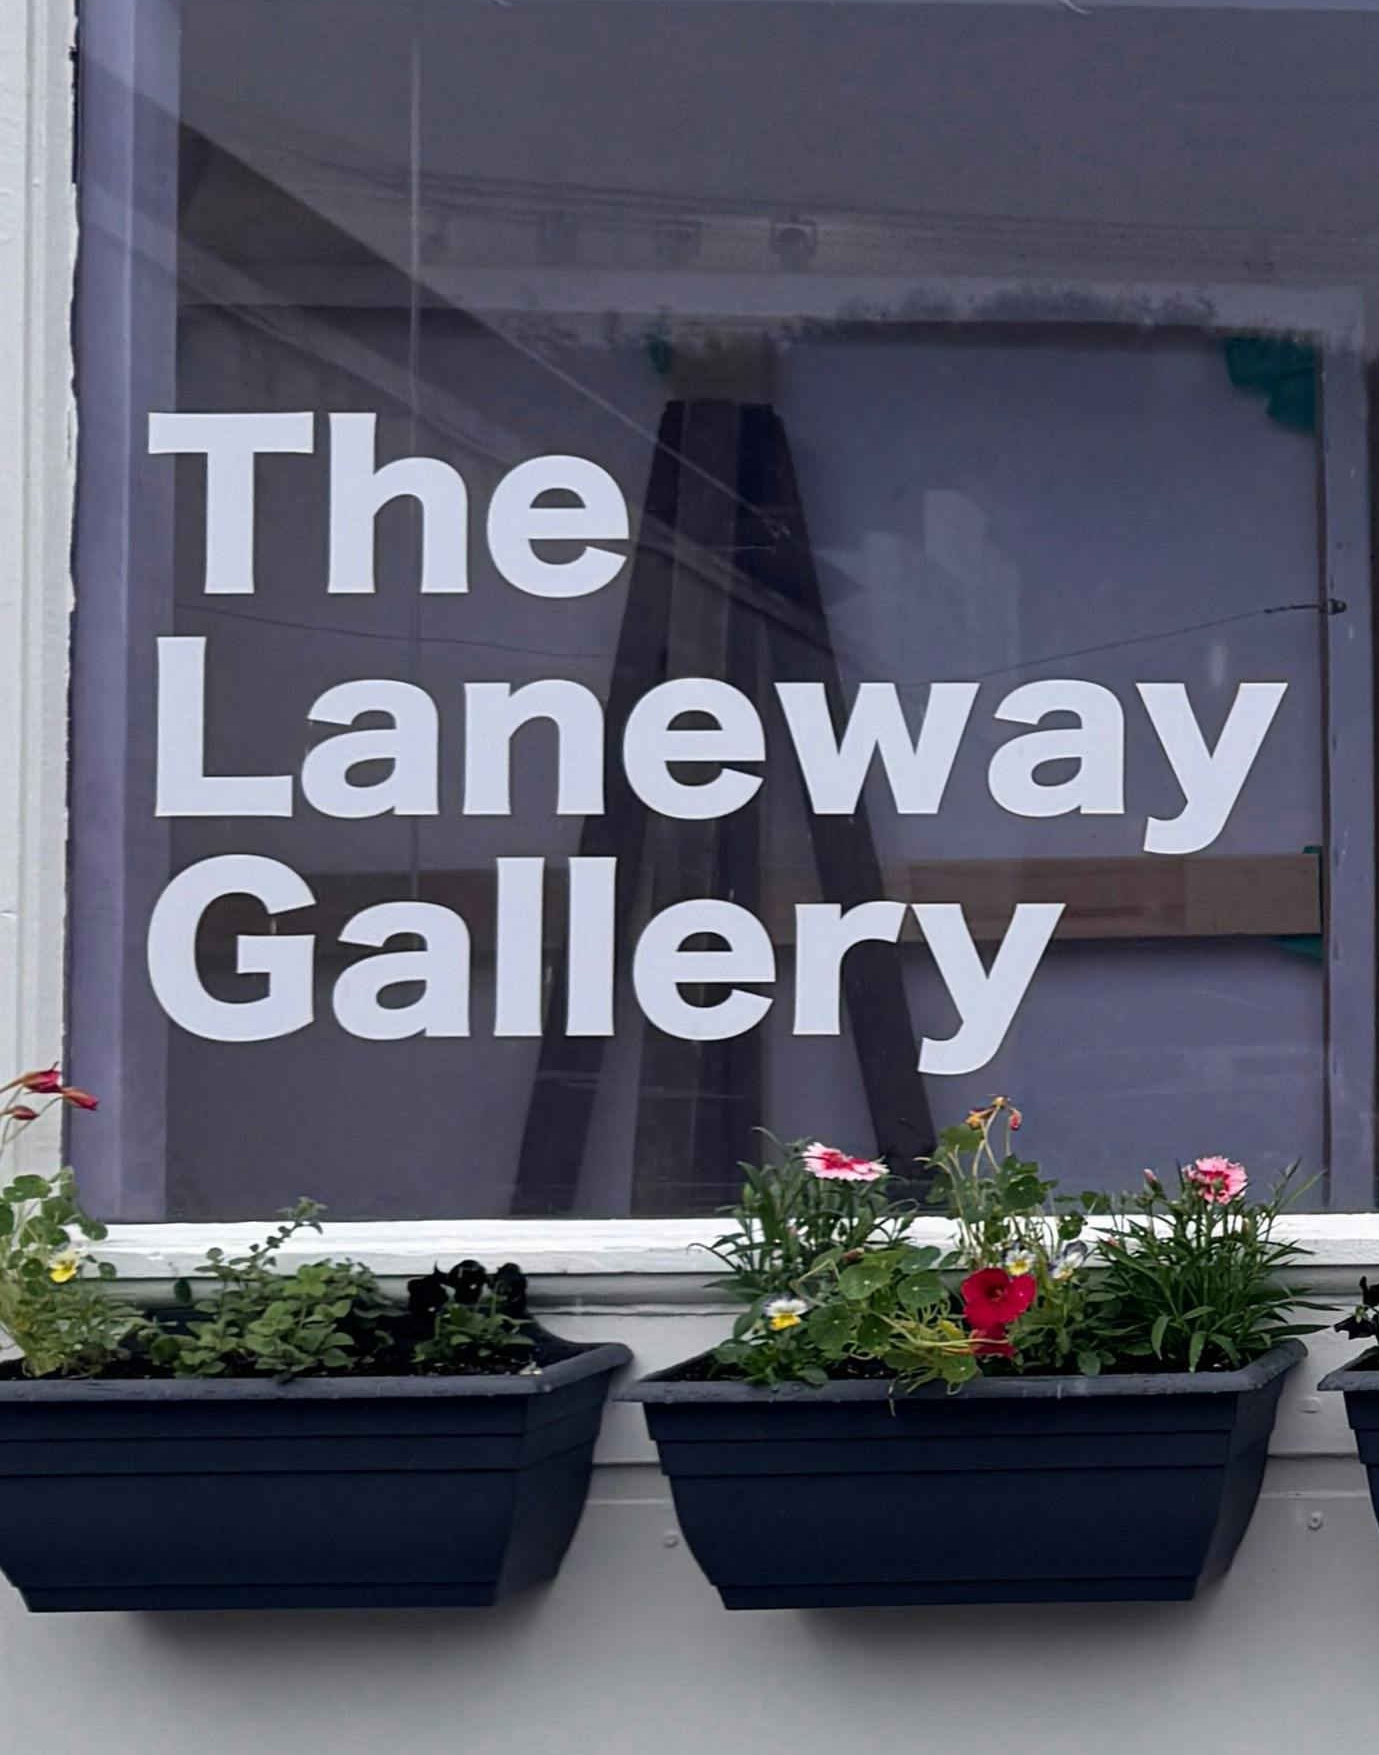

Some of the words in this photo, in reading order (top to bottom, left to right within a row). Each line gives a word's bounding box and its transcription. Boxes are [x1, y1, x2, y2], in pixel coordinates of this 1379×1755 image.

[147, 411, 630, 598] The
[155, 635, 1289, 855] Laneway
[146, 853, 1067, 1076] Gallery
